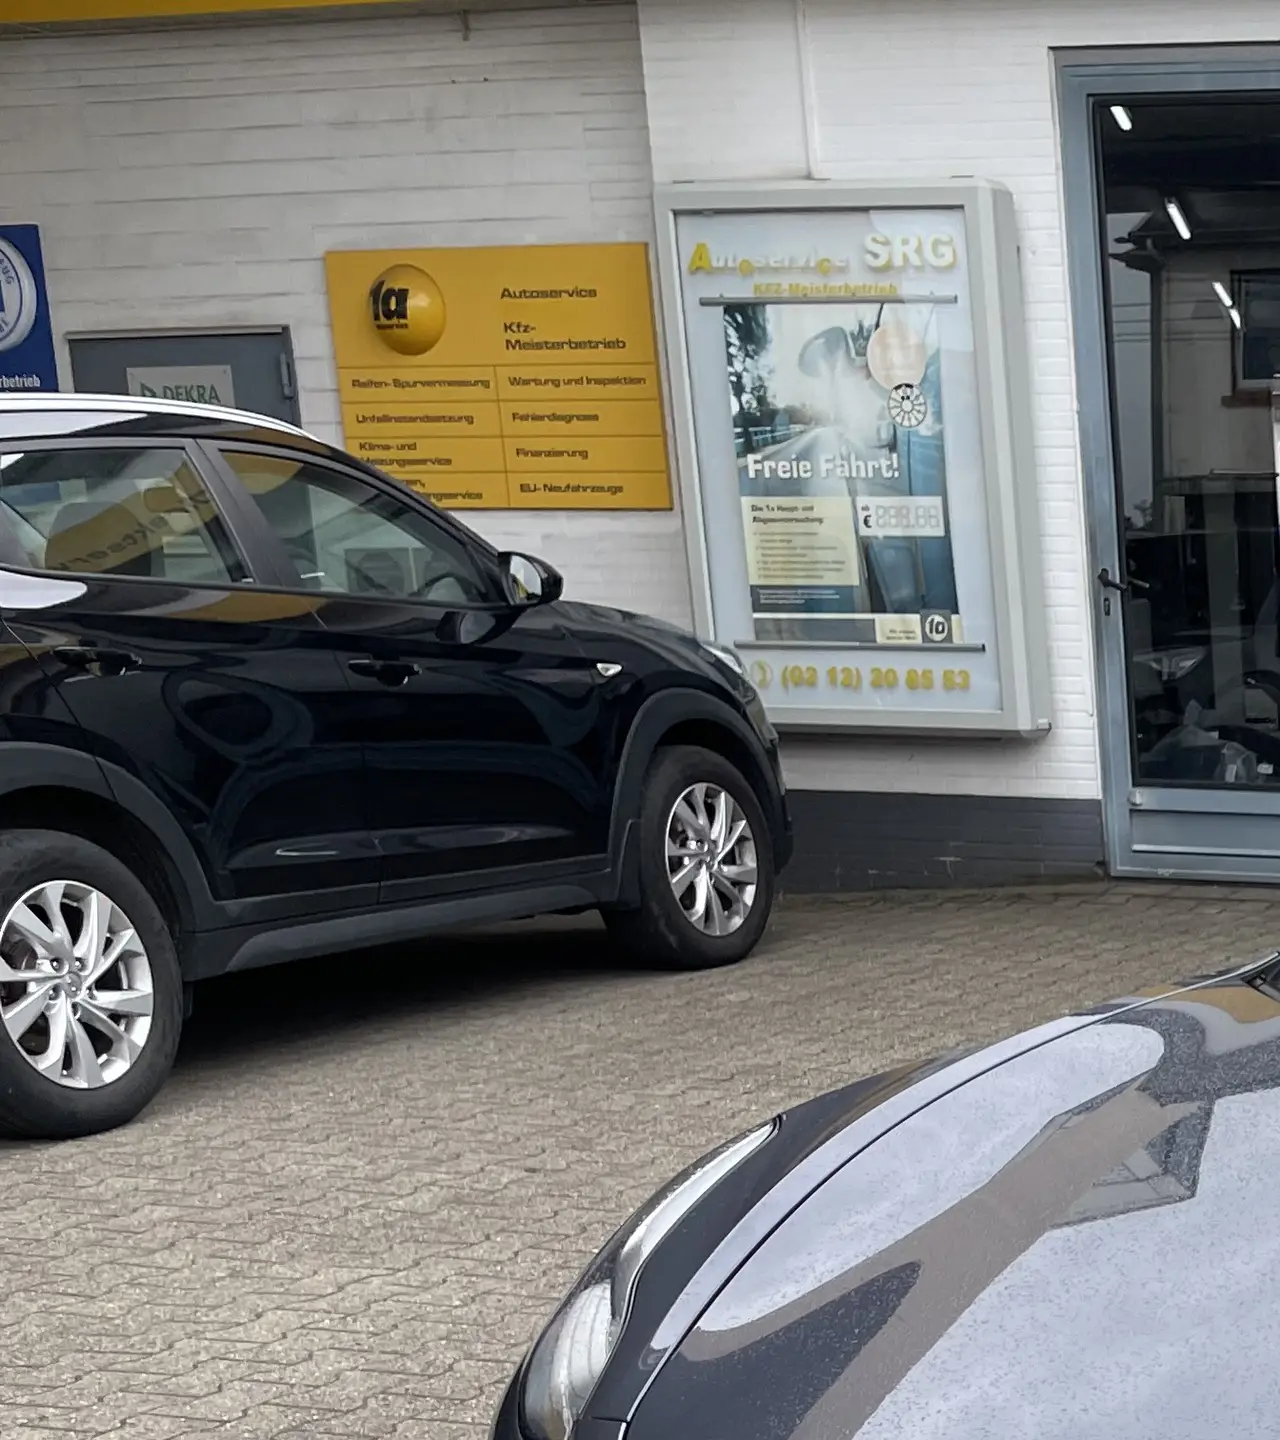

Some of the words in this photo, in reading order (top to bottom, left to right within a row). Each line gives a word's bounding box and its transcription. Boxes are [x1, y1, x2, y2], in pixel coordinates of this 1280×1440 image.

[864, 233, 957, 273] SRG
[500, 287, 598, 300] Autoservice
[503, 322, 536, 334] Kfz-
[505, 338, 626, 350] Meisterbetrieb
[393, 377, 490, 389] Spurvermessung
[508, 376, 561, 388] Wartung
[563, 376, 584, 386] und
[586, 376, 646, 387] Inspektion
[162, 383, 221, 404] DEKRA
[512, 411, 599, 424] Fehlerdiagnose
[397, 442, 417, 451] und
[516, 448, 588, 460] Finanzierung
[747, 454, 813, 479] Freie
[819, 453, 900, 479] Fahrt!
[543, 483, 624, 495] Neufahrzeuge
